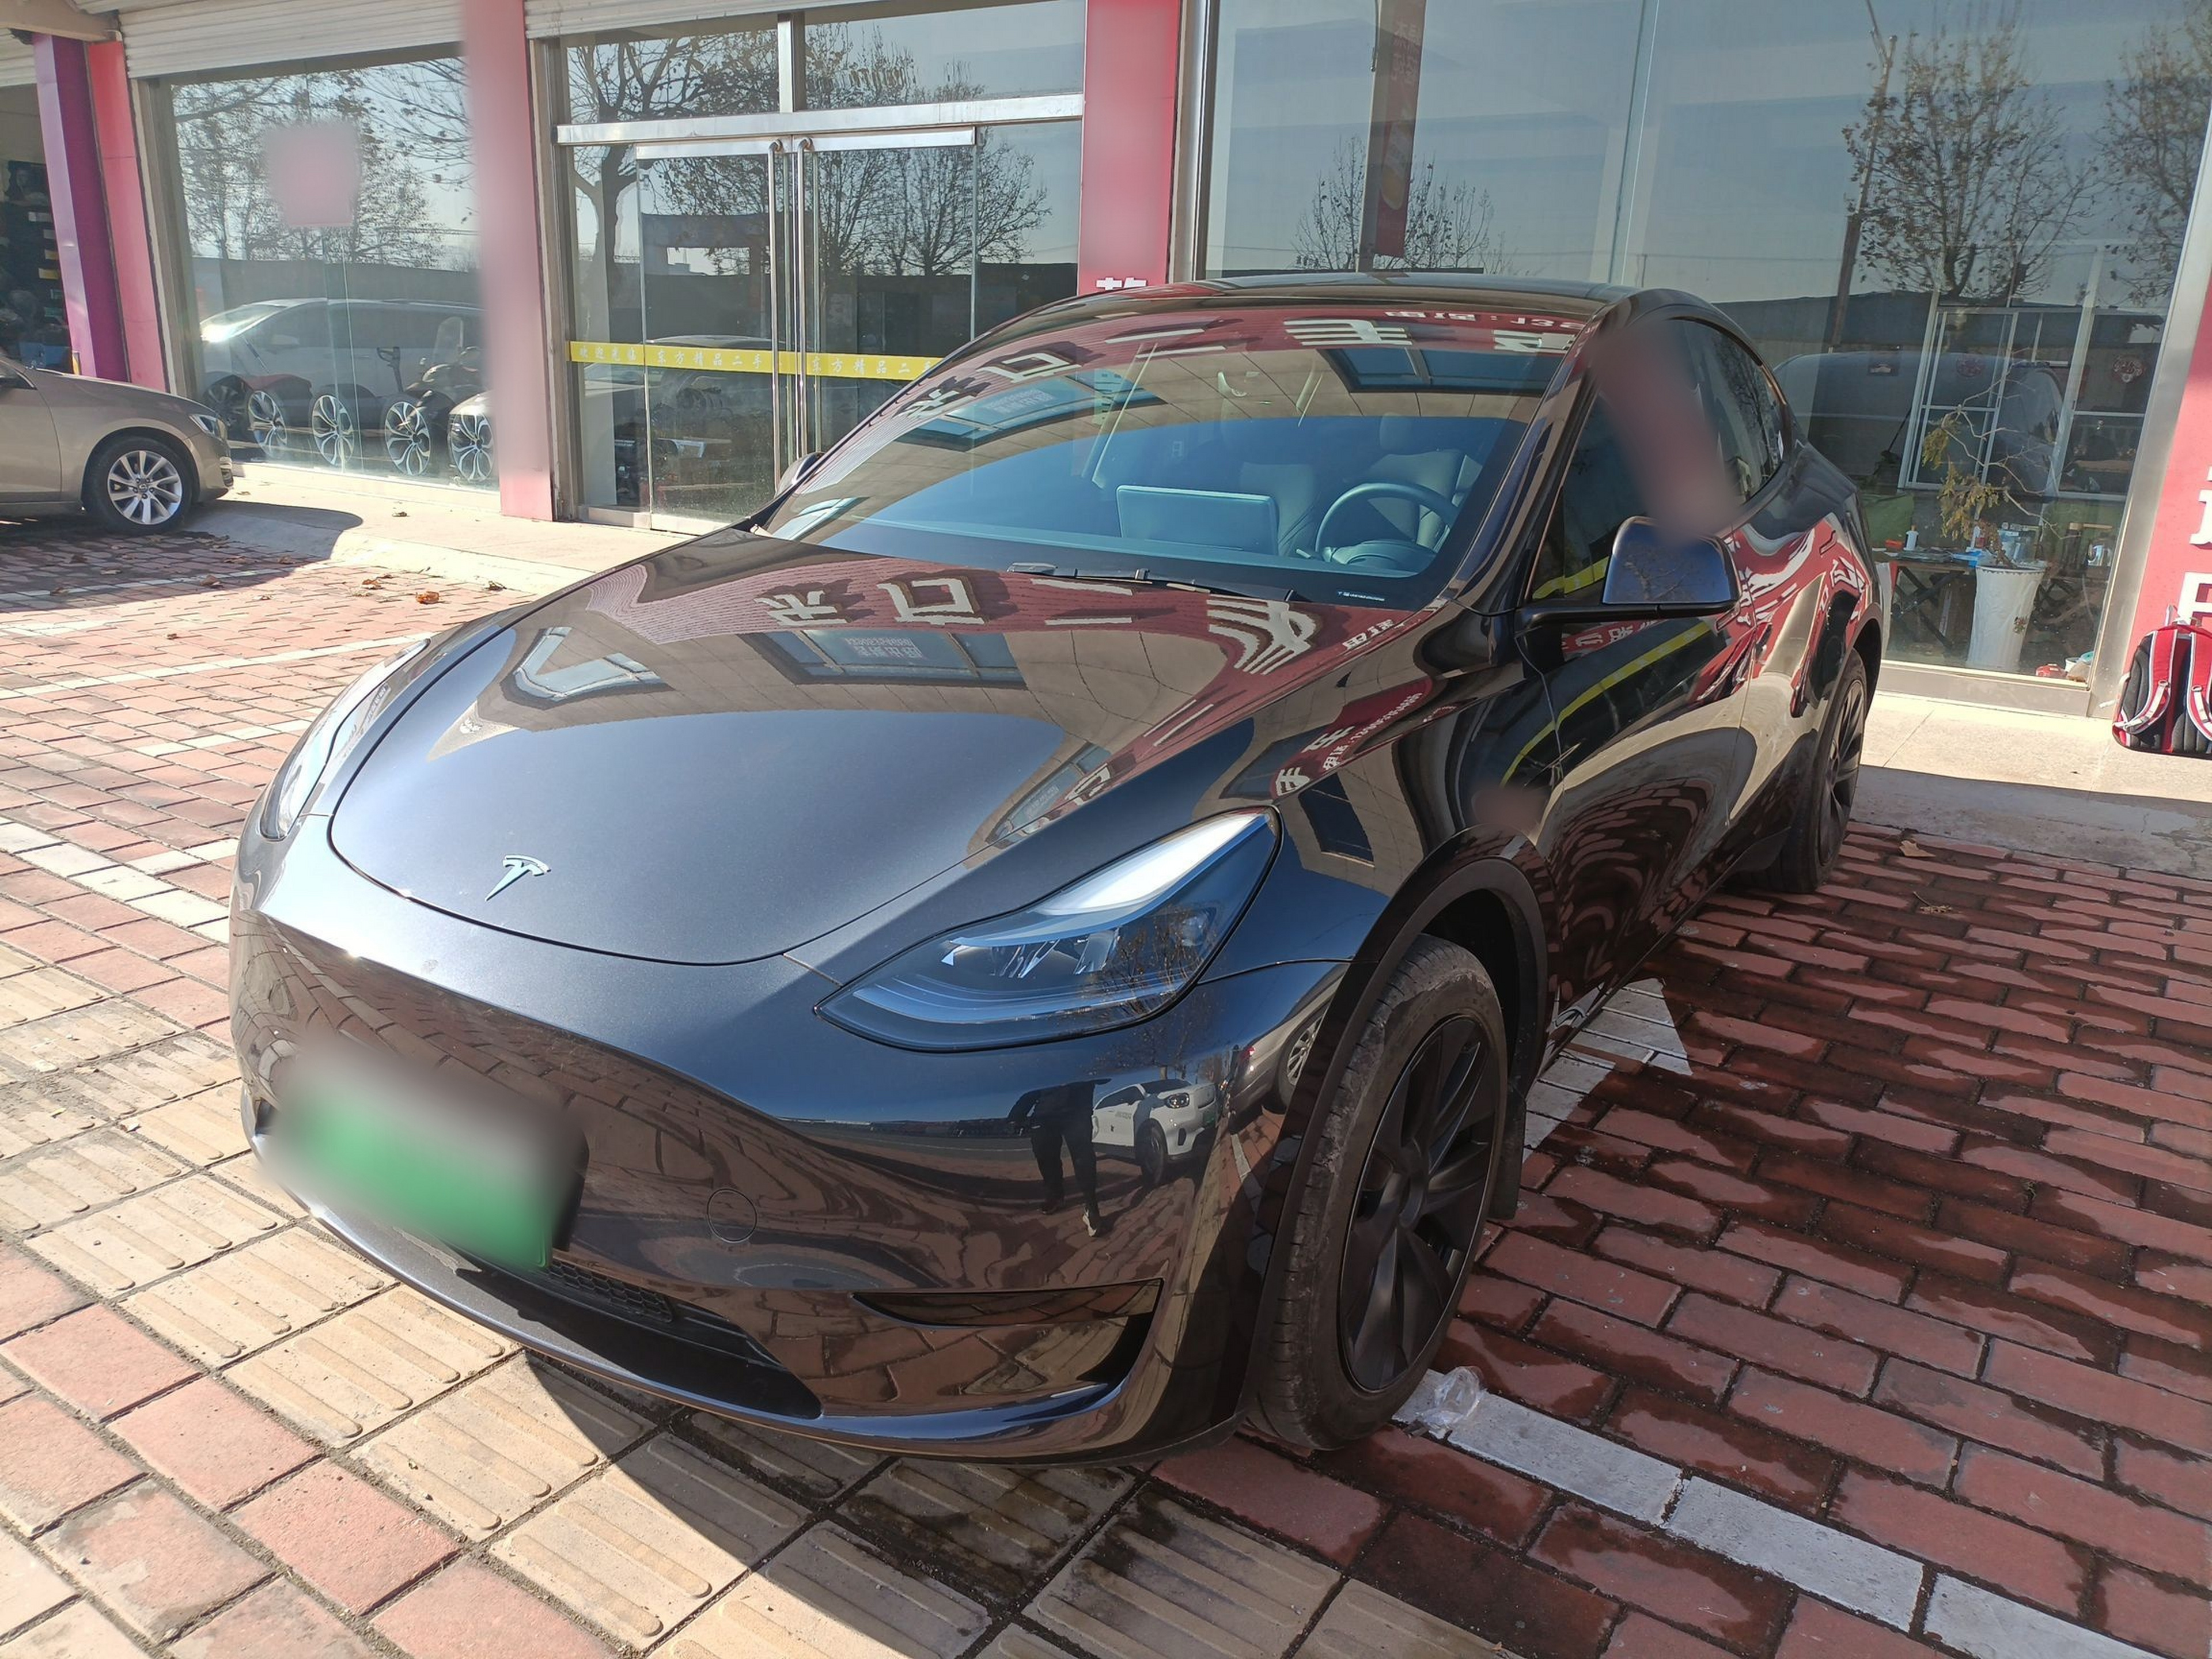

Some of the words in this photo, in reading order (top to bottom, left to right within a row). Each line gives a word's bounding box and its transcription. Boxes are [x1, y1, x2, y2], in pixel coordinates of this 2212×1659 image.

[658, 350, 763, 370] 东方精品二手
